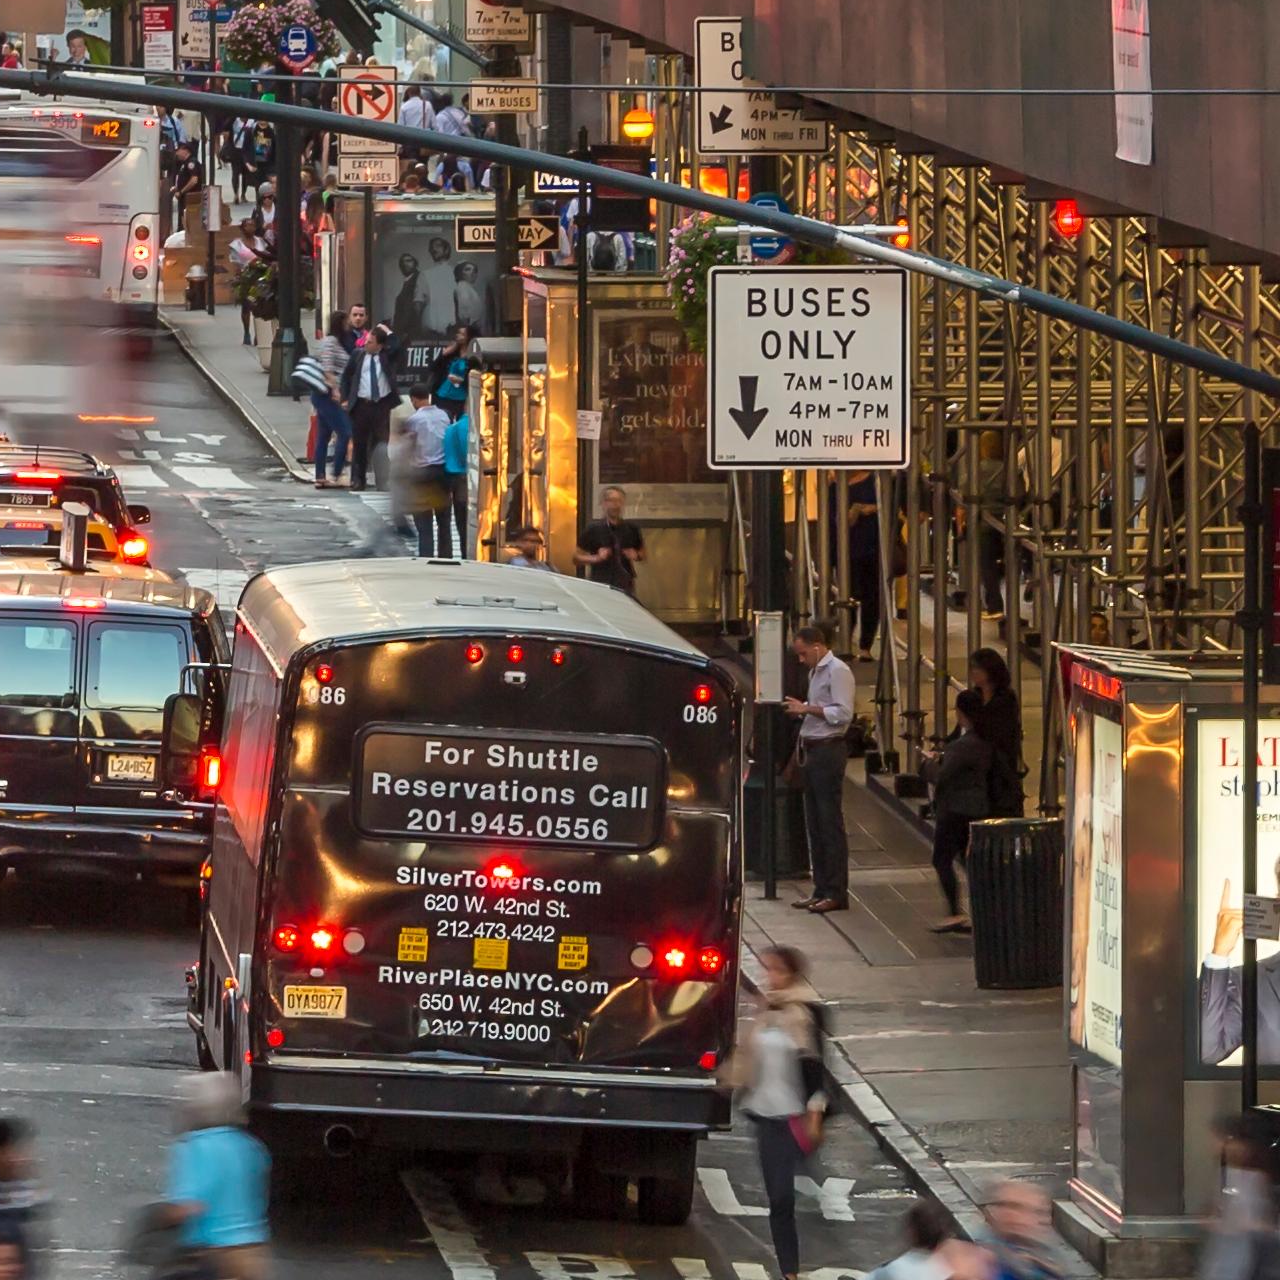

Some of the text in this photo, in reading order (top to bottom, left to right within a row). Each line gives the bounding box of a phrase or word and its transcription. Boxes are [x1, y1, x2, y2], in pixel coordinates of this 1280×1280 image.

[468, 28, 495, 36] EXCEPT
[476, 96, 531, 108] MTA BUSES
[741, 128, 766, 141] MON
[800, 128, 818, 140] FRI
[352, 160, 384, 169] EXCEPT
[344, 174, 360, 182] MTA
[747, 288, 870, 318] BUSES
[761, 330, 856, 360] ONLY
[407, 347, 430, 368] THE
[636, 383, 692, 398] never
[620, 406, 706, 433] gets old.
[776, 430, 890, 448] MON THRU FRI
[682, 704, 718, 724] 086
[424, 741, 599, 773] For Shuttle
[372, 772, 648, 809] Reservations Call
[407, 808, 609, 841] 201.945.0556
[396, 866, 602, 895] SilverTowers.com
[424, 894, 570, 919] 620 W. 42nd St.
[436, 920, 556, 943] 212.473.4242
[378, 966, 609, 996] RiverPlaceNYC.com
[419, 994, 566, 1018] 650 W. 42nd St.
[430, 1018, 551, 1043] 212.719.9000
